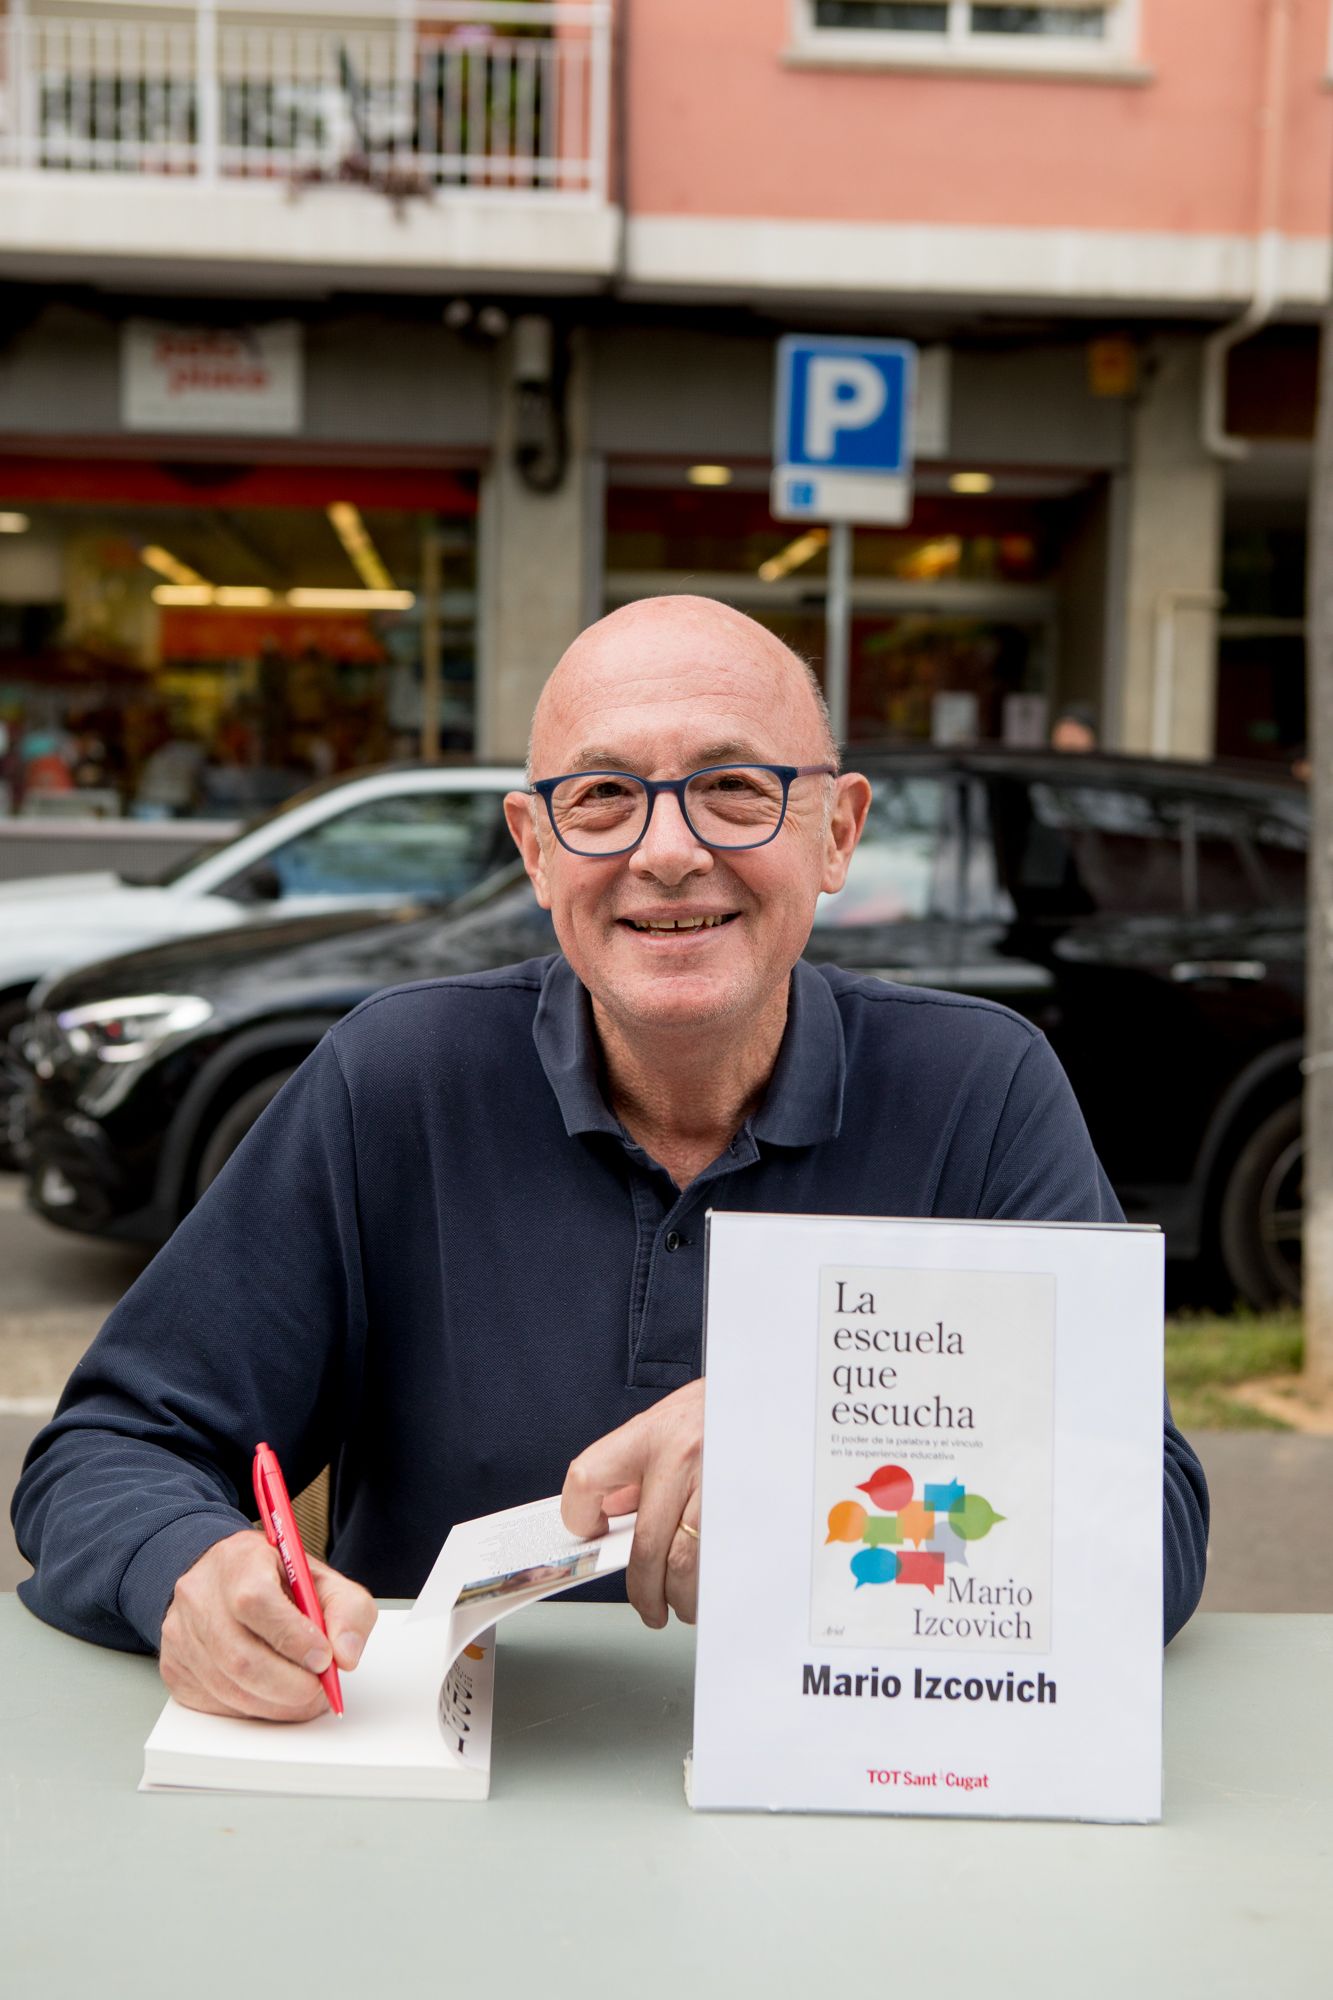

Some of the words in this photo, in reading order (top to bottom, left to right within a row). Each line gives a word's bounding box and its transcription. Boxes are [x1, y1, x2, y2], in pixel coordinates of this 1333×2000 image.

[804, 356, 888, 461] P
[835, 1281, 876, 1314] La
[834, 1321, 964, 1354] escuela
[833, 1365, 897, 1395] que
[832, 1394, 975, 1429] escucha
[831, 1434, 839, 1443] El
[842, 1435, 869, 1446] poder
[872, 1436, 883, 1445] de
[886, 1436, 894, 1445] la
[896, 1437, 930, 1448] palabra
[941, 1438, 949, 1446] el
[831, 1449, 842, 1457] en
[845, 1448, 853, 1457] la
[855, 1449, 908, 1460] experiencia
[910, 1450, 955, 1461] educativa
[947, 1576, 1033, 1606] Mario
[913, 1608, 1033, 1640] Izcovich
[802, 1664, 902, 1699] Mario
[914, 1668, 1057, 1704] Izcovich
[867, 1769, 901, 1784] TOT
[903, 1771, 937, 1786] Sant
[945, 1772, 989, 1791] Cugat
